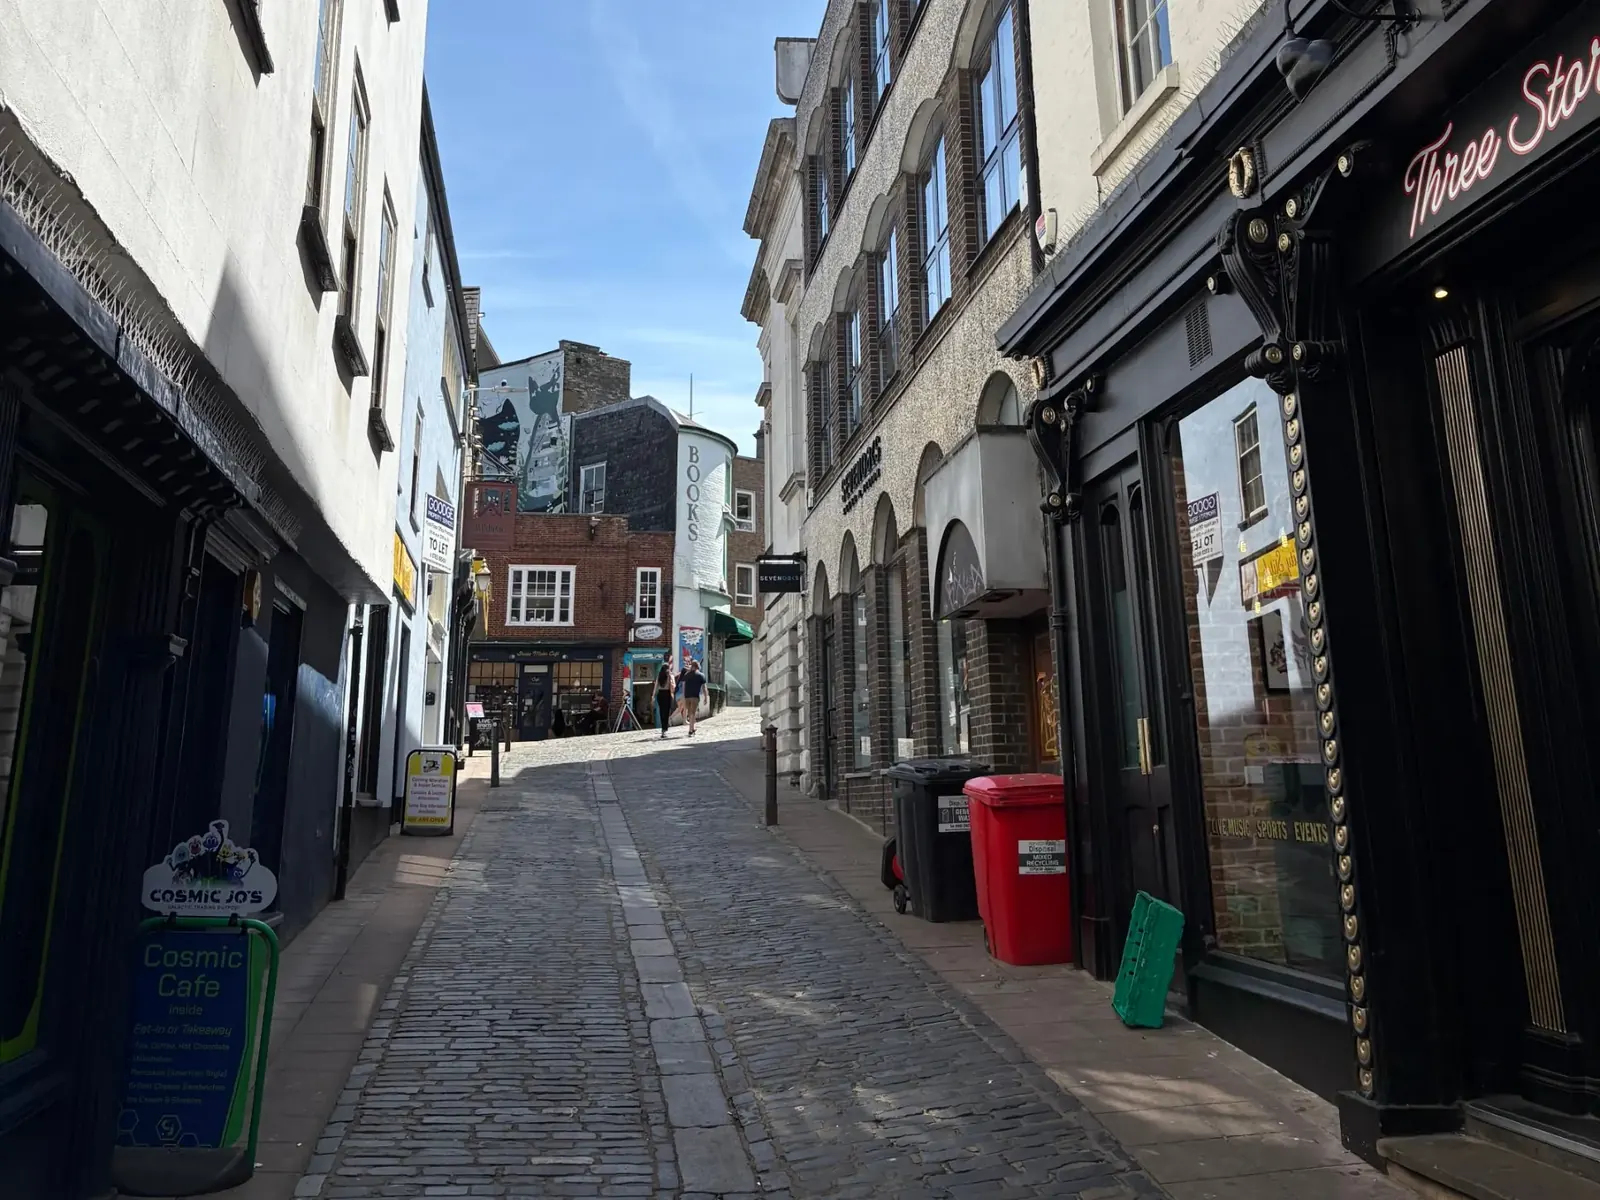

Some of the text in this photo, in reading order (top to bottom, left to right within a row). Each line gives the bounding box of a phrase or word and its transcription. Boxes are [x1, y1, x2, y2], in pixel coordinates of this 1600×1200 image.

[1404, 121, 1501, 239] Three
[686, 446, 700, 542] BOOKS
[428, 497, 454, 521] GOODGE
[429, 537, 448, 556] TO LET
[1211, 817, 1330, 845] LIVE MUSIC SPORTS EVENTS
[1026, 859, 1060, 867] RECYCLING
[143, 944, 244, 969] Cosmic
[158, 973, 220, 998] Cafe
[182, 1024, 233, 1039] Takeaway
